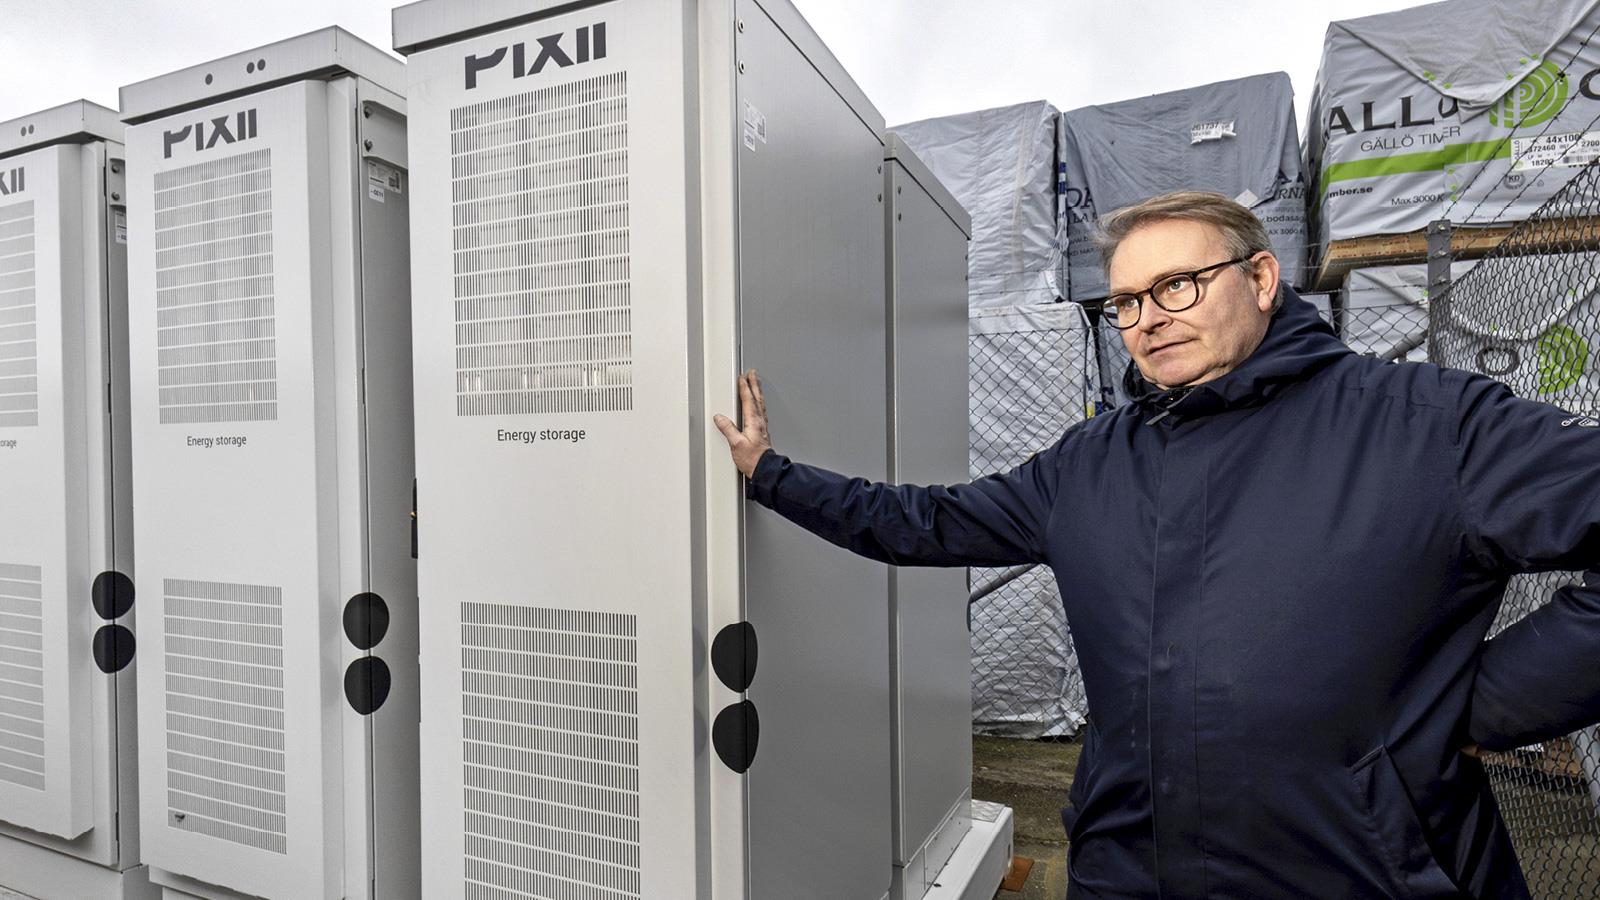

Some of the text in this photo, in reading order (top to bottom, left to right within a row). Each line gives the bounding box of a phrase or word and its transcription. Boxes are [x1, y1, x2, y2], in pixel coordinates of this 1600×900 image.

[465, 22, 607, 90] PIXII
[163, 108, 257, 160] PIXII
[1360, 134, 1414, 152] GÄLLÖ
[1391, 198, 1412, 206] Max
[187, 435, 247, 448] Energy storage
[497, 428, 586, 444] Energy storage
